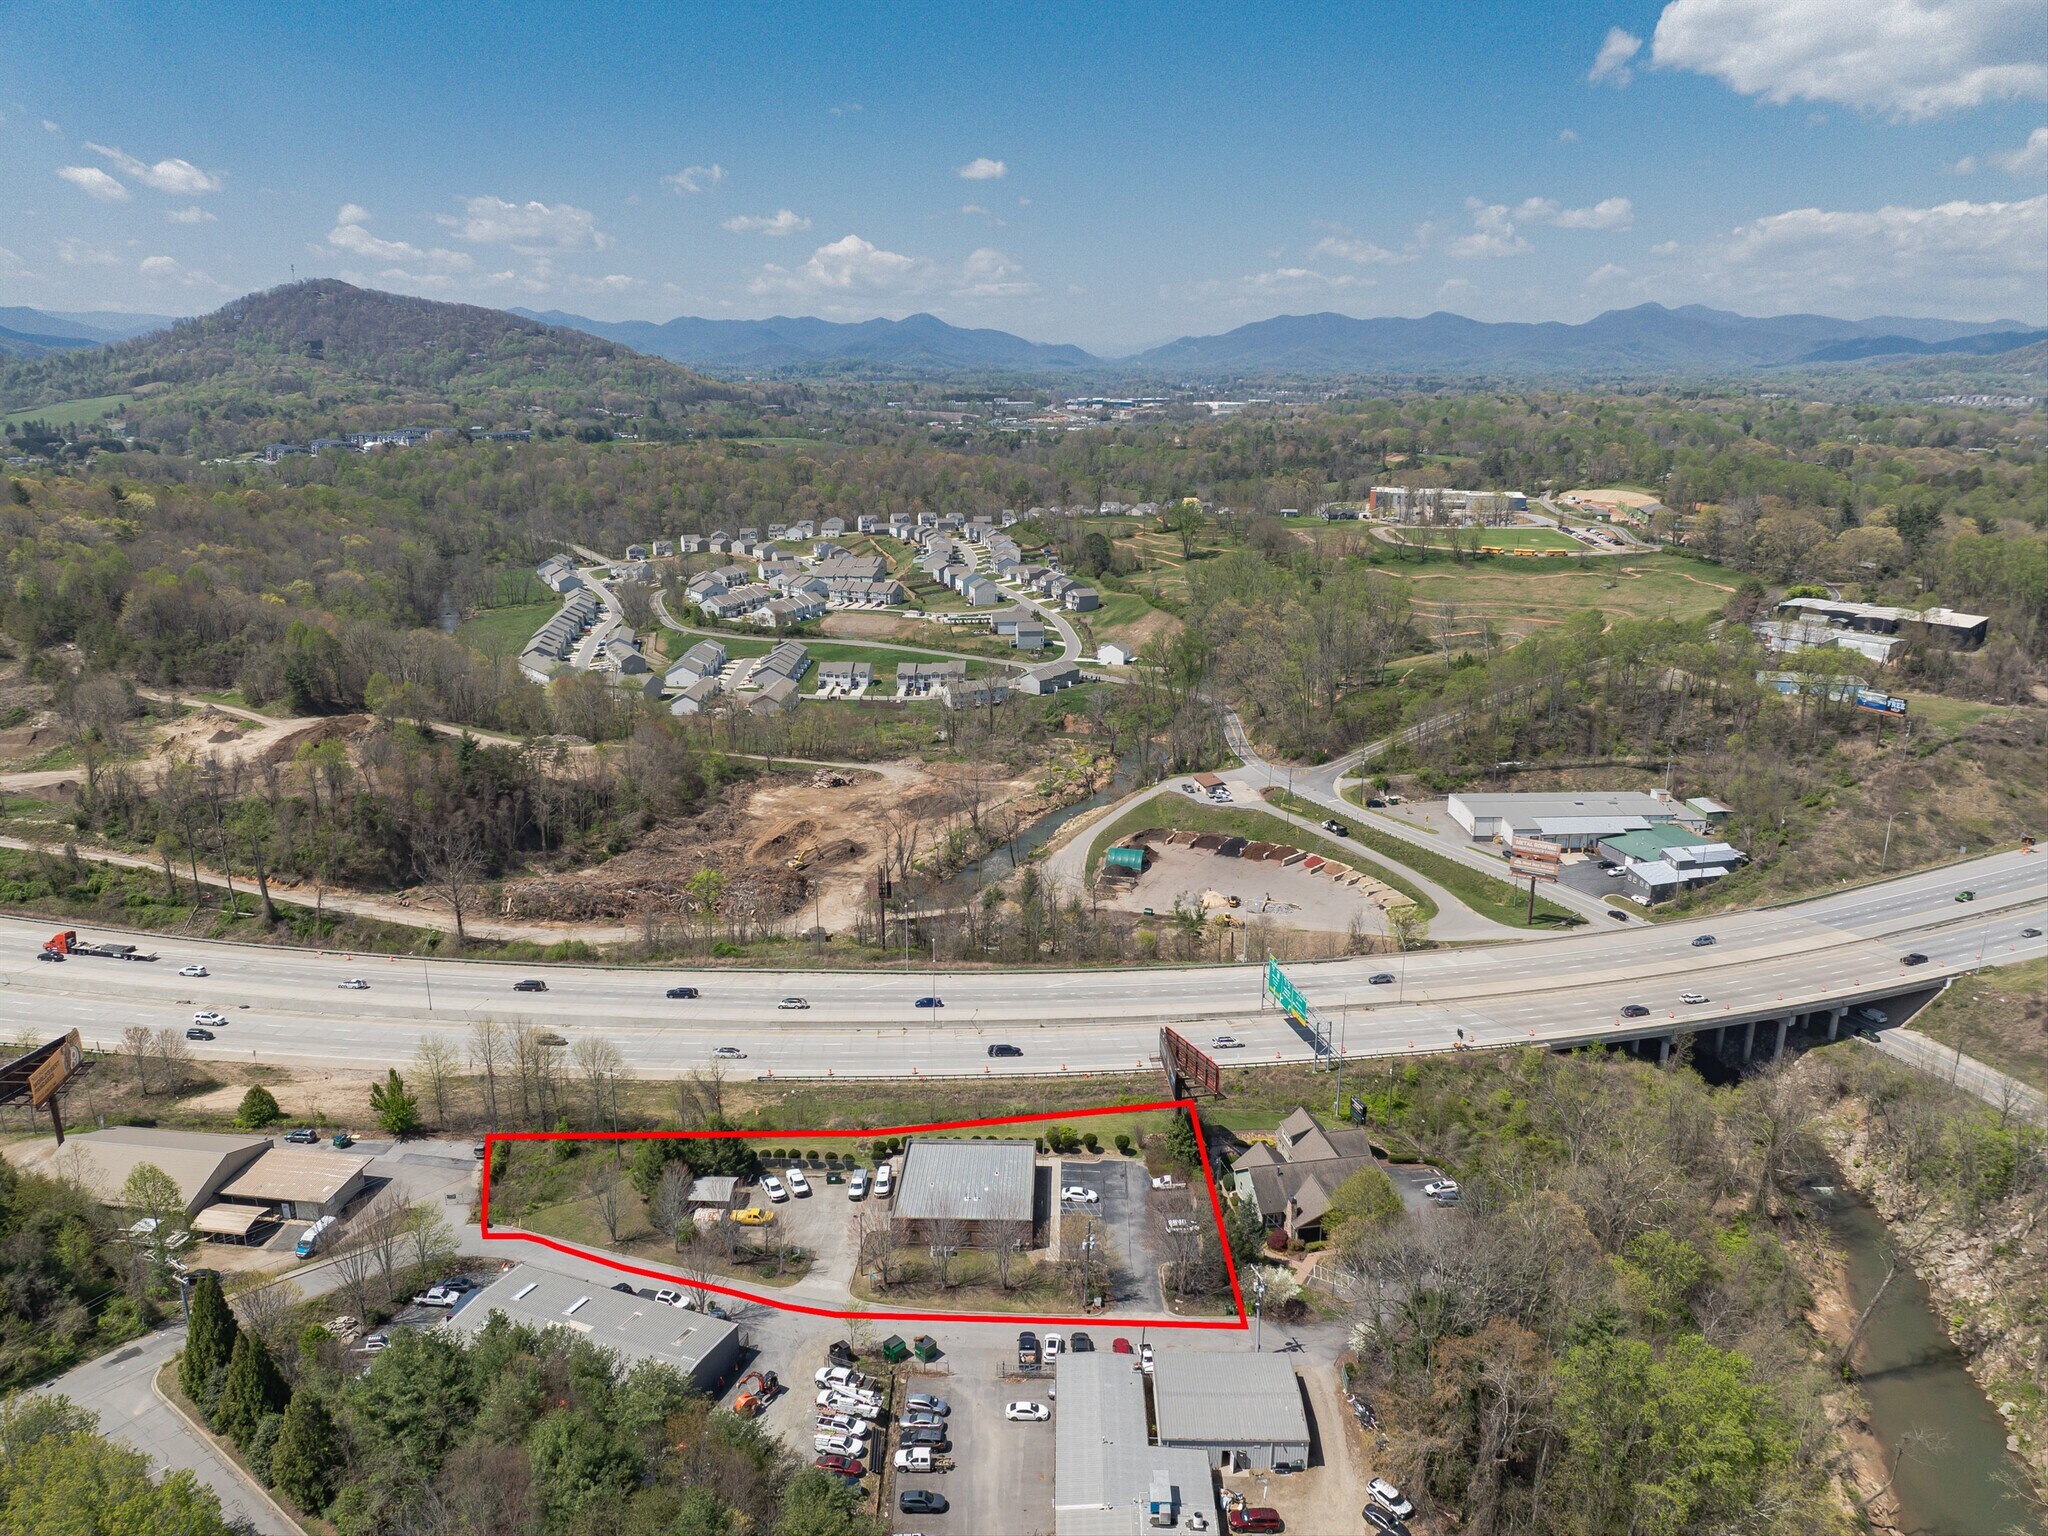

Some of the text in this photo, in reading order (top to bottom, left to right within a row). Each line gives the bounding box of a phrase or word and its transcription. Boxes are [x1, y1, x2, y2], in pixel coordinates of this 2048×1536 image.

[1887, 700, 1906, 709] FREE
[1516, 839, 1557, 851] METAL ROOFING
